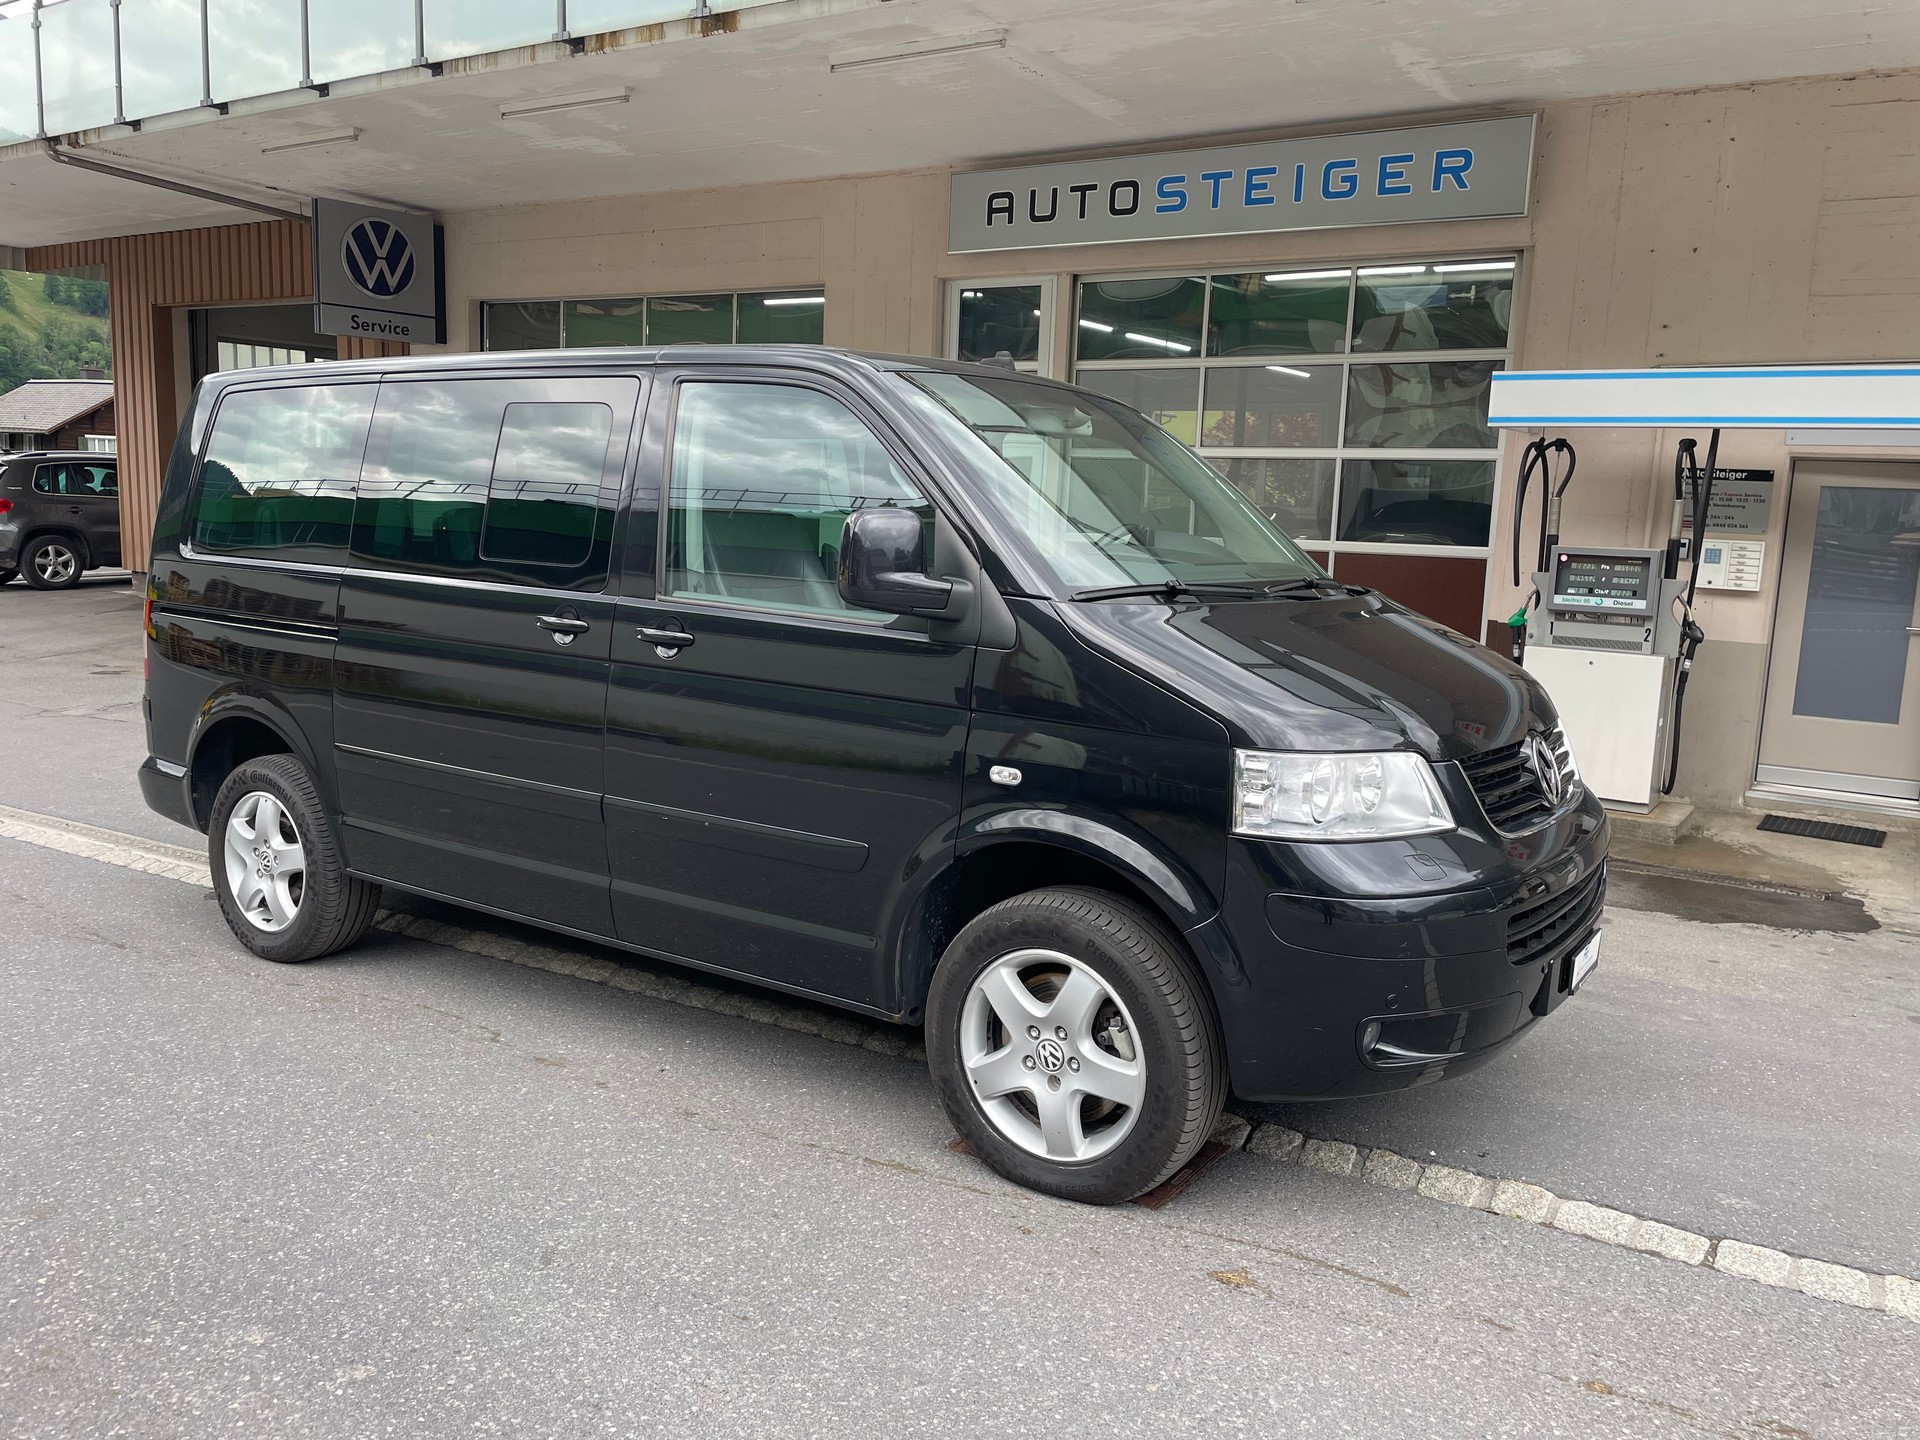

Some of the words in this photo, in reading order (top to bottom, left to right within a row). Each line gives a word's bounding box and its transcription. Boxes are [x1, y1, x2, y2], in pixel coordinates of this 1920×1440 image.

[350, 314, 410, 336] Service
[1613, 599, 1634, 607] Diesel
[1549, 621, 1554, 636] 1
[1643, 627, 1652, 643] 2
[250, 769, 293, 804] Continental
